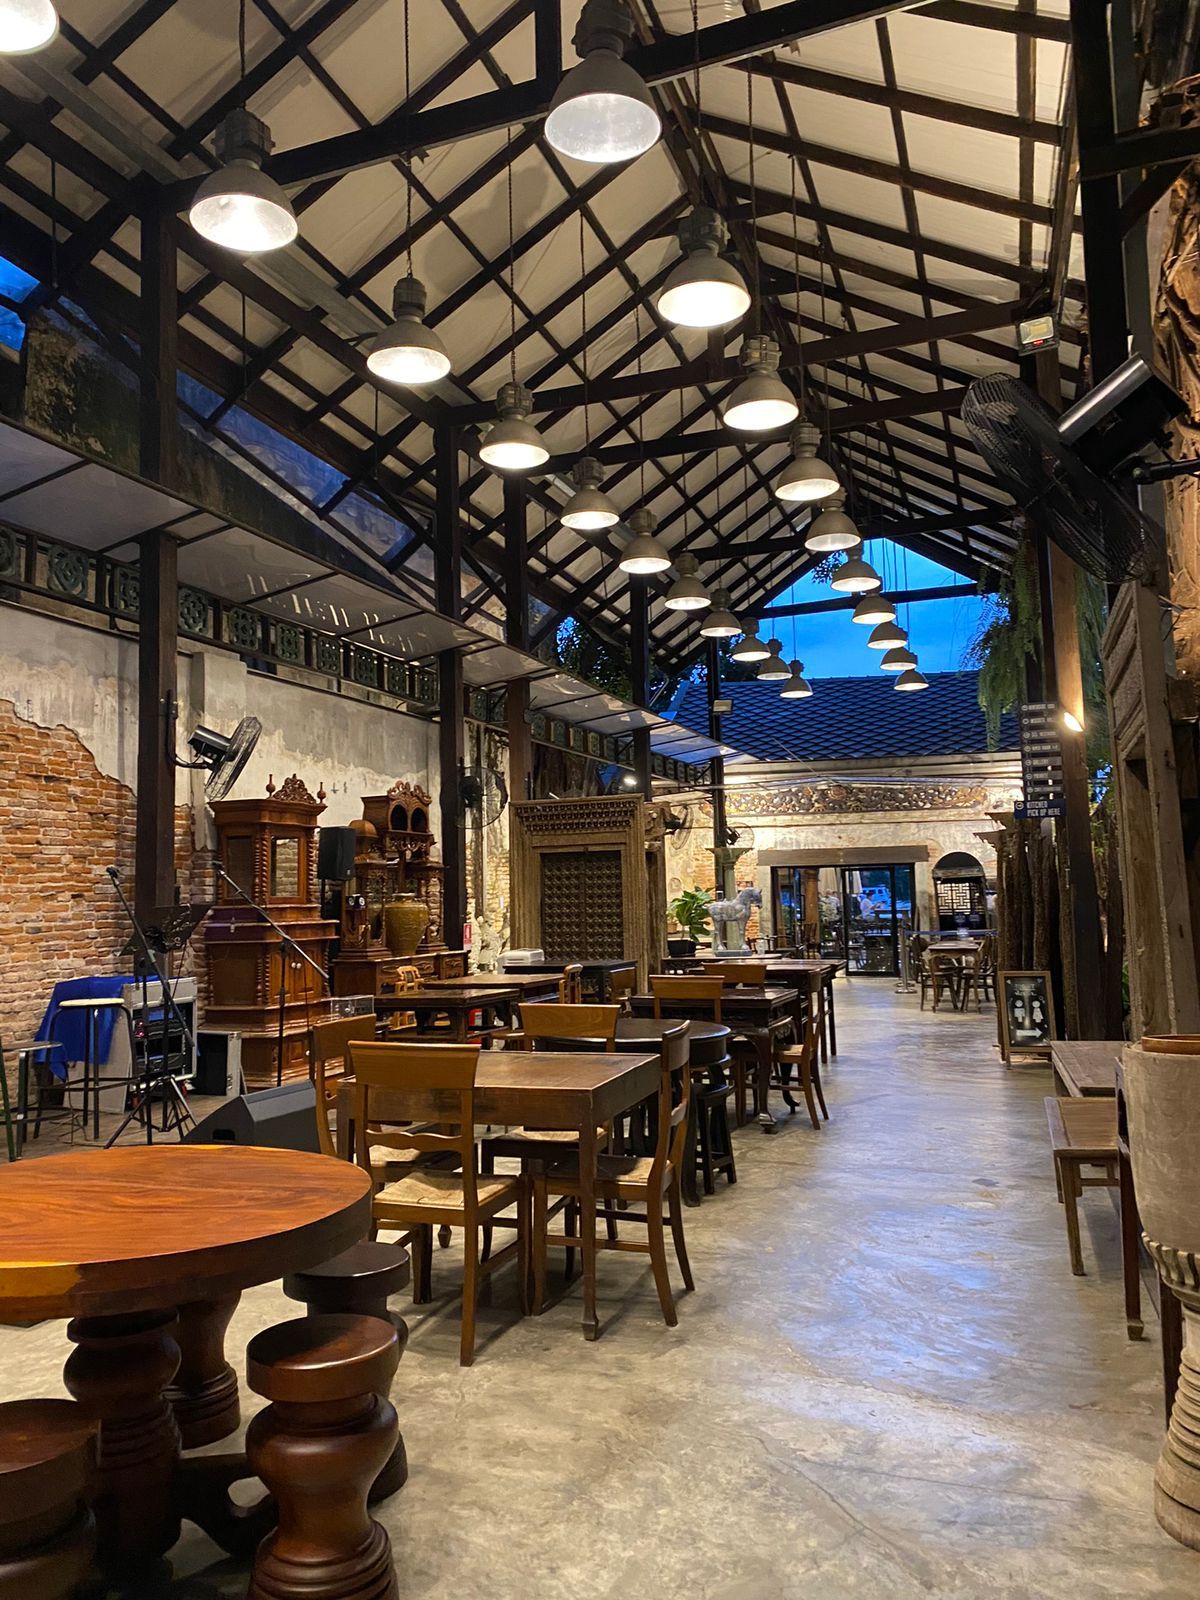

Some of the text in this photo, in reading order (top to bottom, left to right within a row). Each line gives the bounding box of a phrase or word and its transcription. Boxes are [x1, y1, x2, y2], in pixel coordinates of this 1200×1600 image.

[1027, 807, 1061, 817] PICK UP HERE
